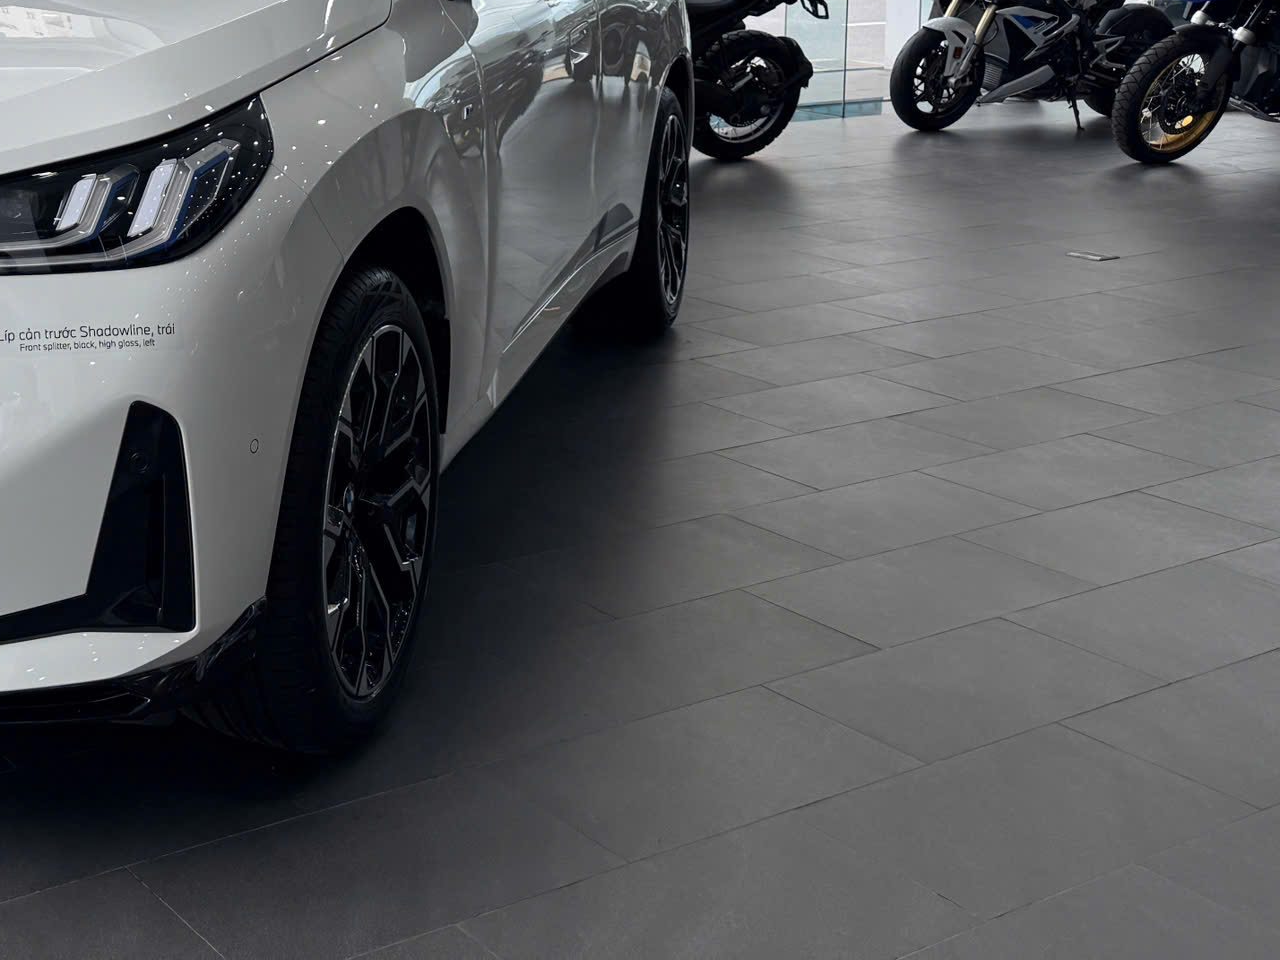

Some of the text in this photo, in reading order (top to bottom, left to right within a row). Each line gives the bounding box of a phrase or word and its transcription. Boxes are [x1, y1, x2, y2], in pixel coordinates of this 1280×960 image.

[80, 324, 154, 338] Shadowline,
[157, 323, 175, 335] trái
[20, 338, 155, 352] Front splitter, black, high gloss, left
